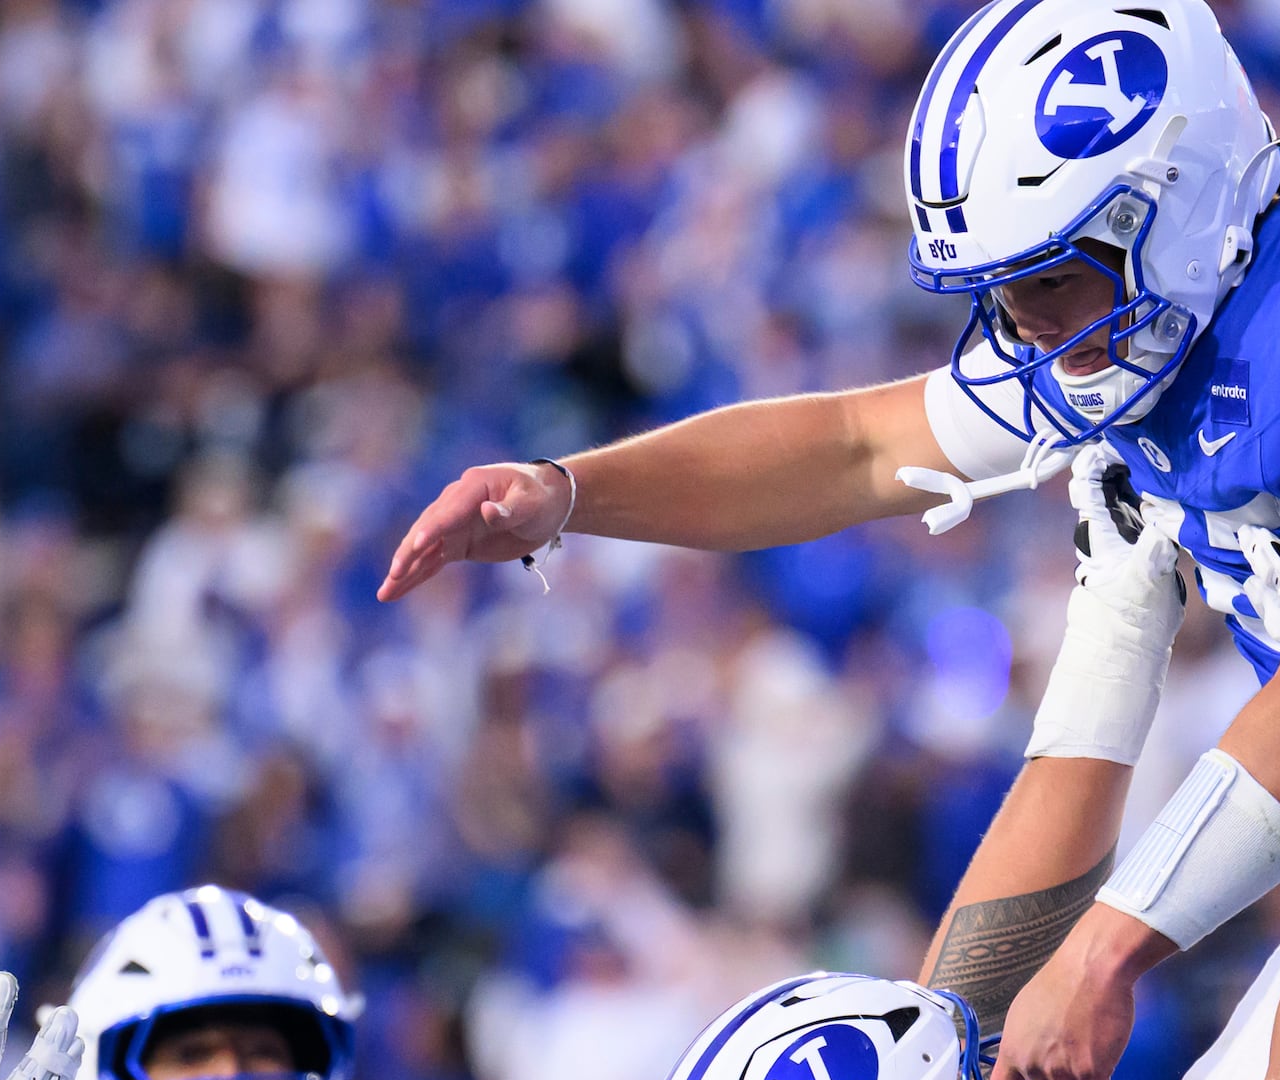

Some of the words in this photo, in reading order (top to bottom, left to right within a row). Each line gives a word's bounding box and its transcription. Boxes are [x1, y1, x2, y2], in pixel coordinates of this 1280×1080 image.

[1043, 38, 1148, 135] Y
[928, 239, 957, 261] BYU
[1077, 392, 1104, 407] COUGS
[1211, 384, 1247, 400] entrata
